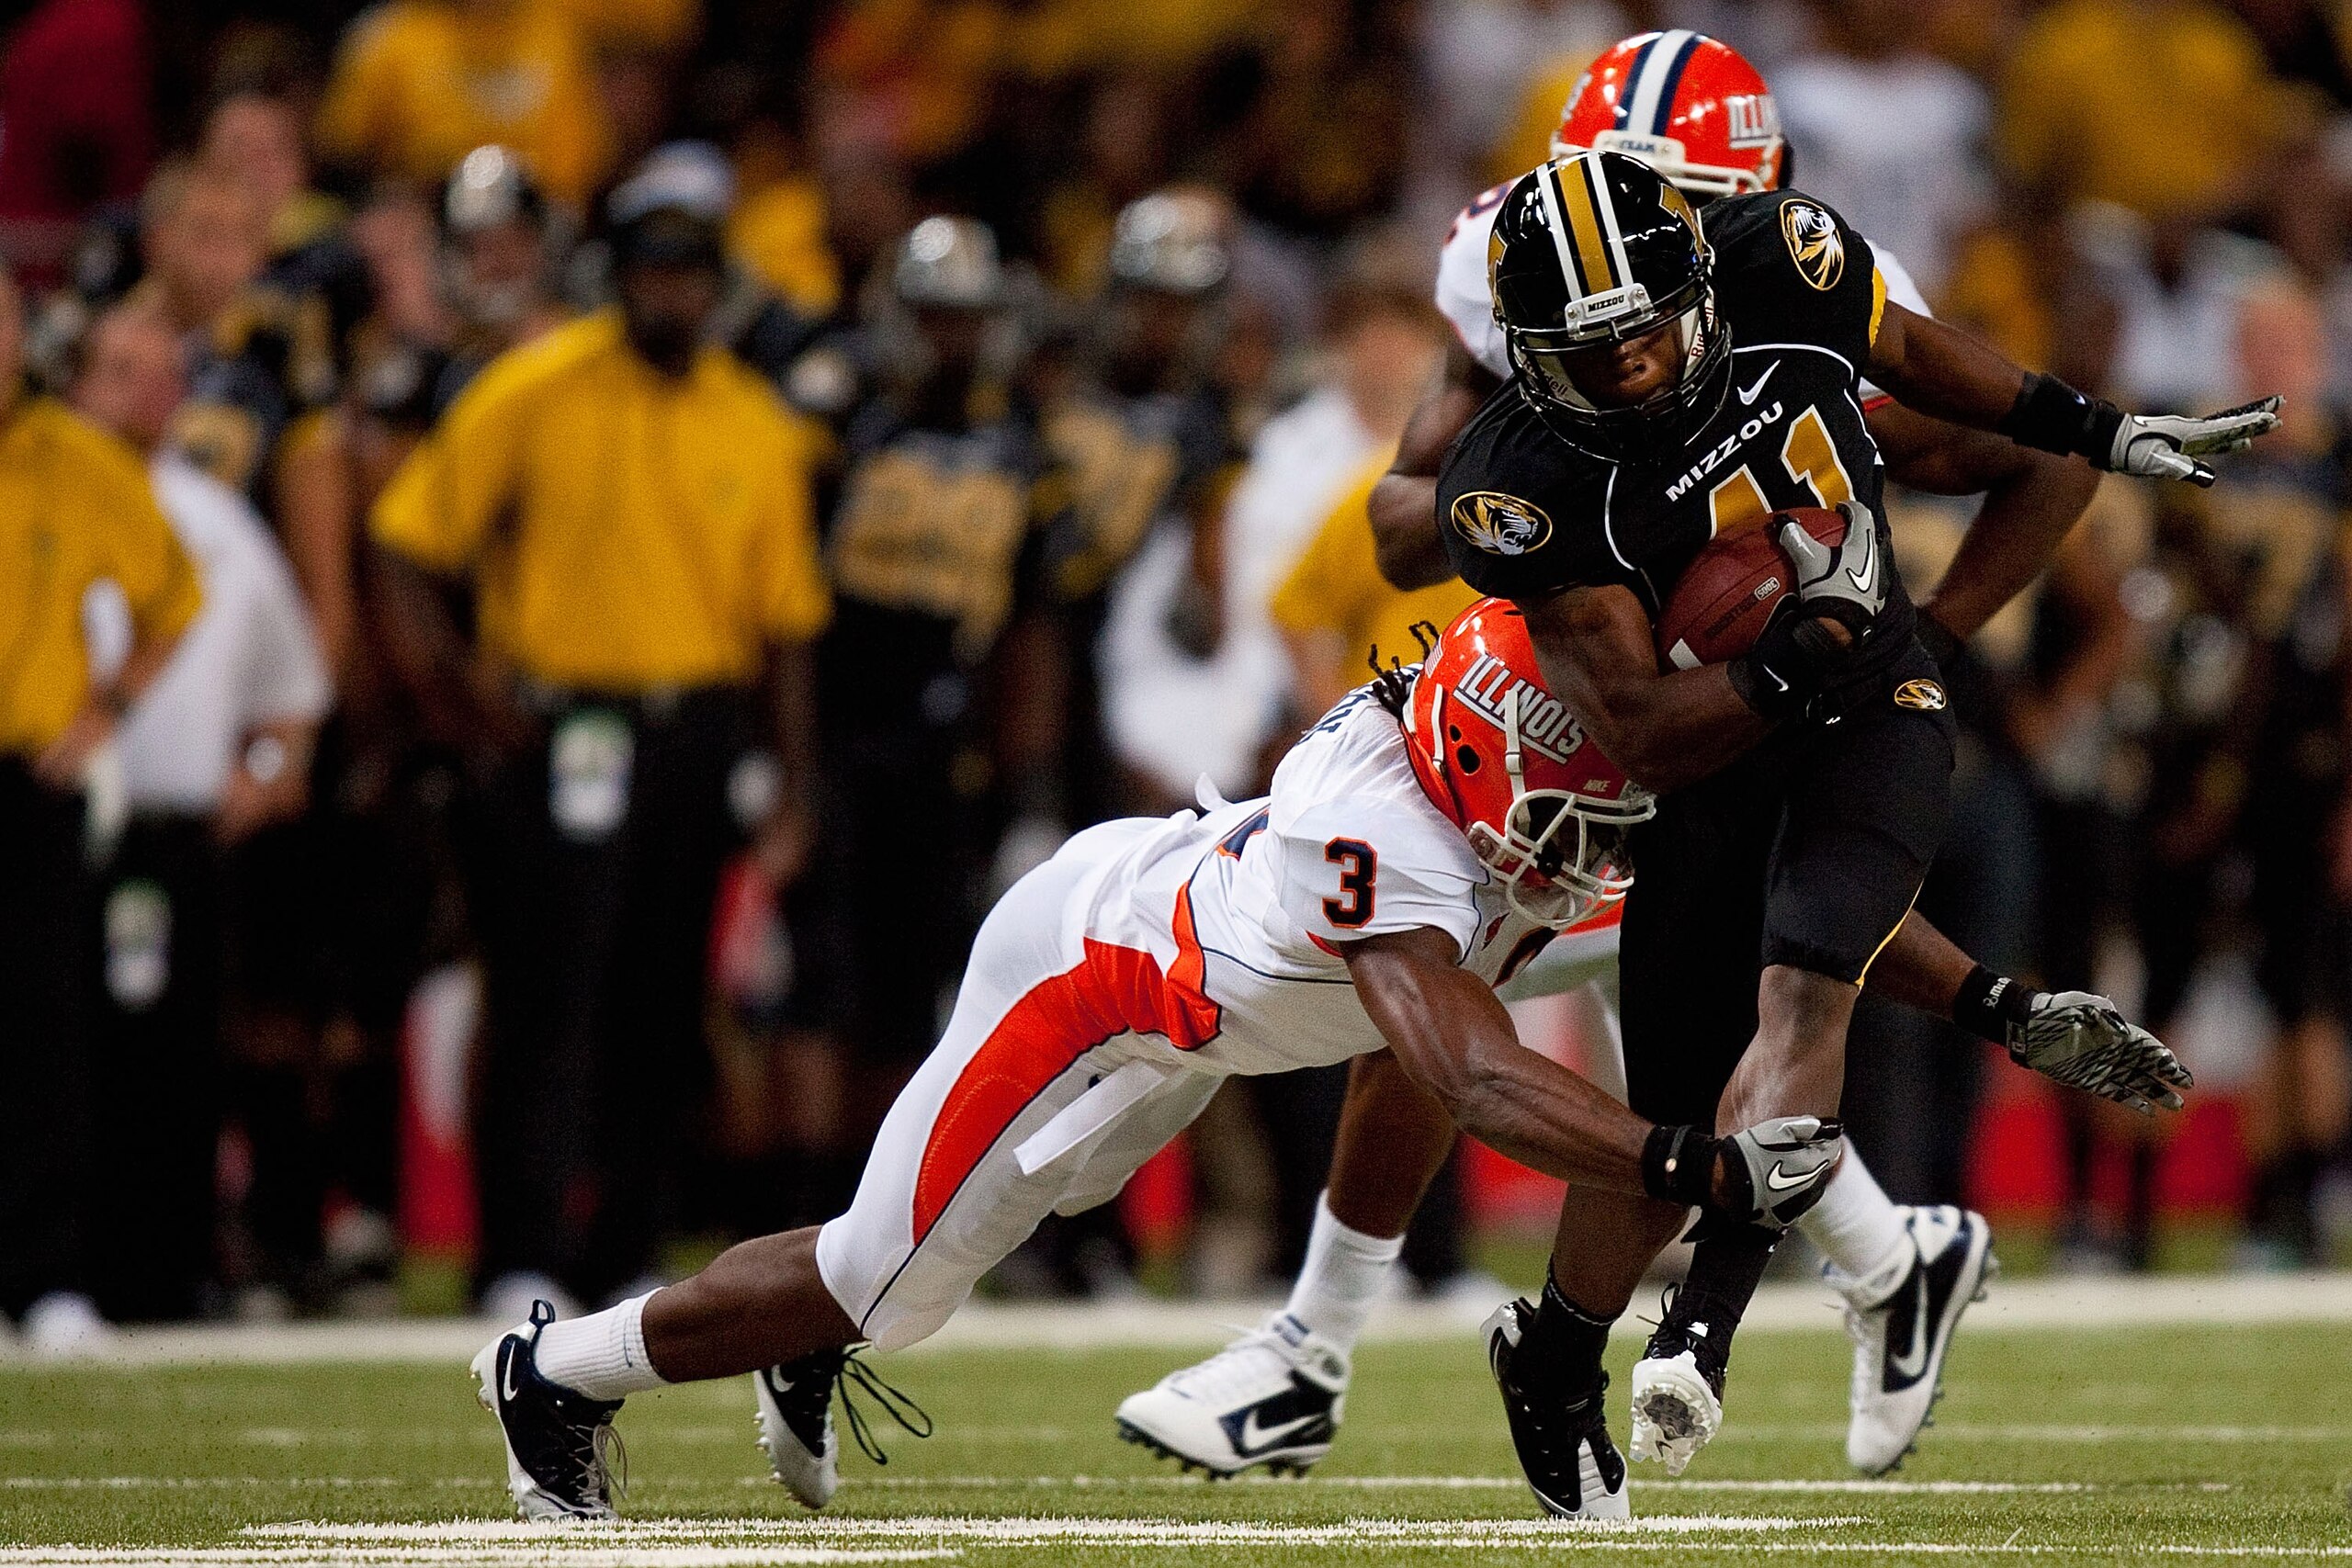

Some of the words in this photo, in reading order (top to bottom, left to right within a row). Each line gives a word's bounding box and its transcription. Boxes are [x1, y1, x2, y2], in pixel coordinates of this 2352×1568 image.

[1587, 294, 1625, 312] MIZZOU
[1666, 400, 1783, 502] MIZZOU
[1457, 654, 1584, 755] ILLINOIS
[1321, 836, 1378, 929] 3
